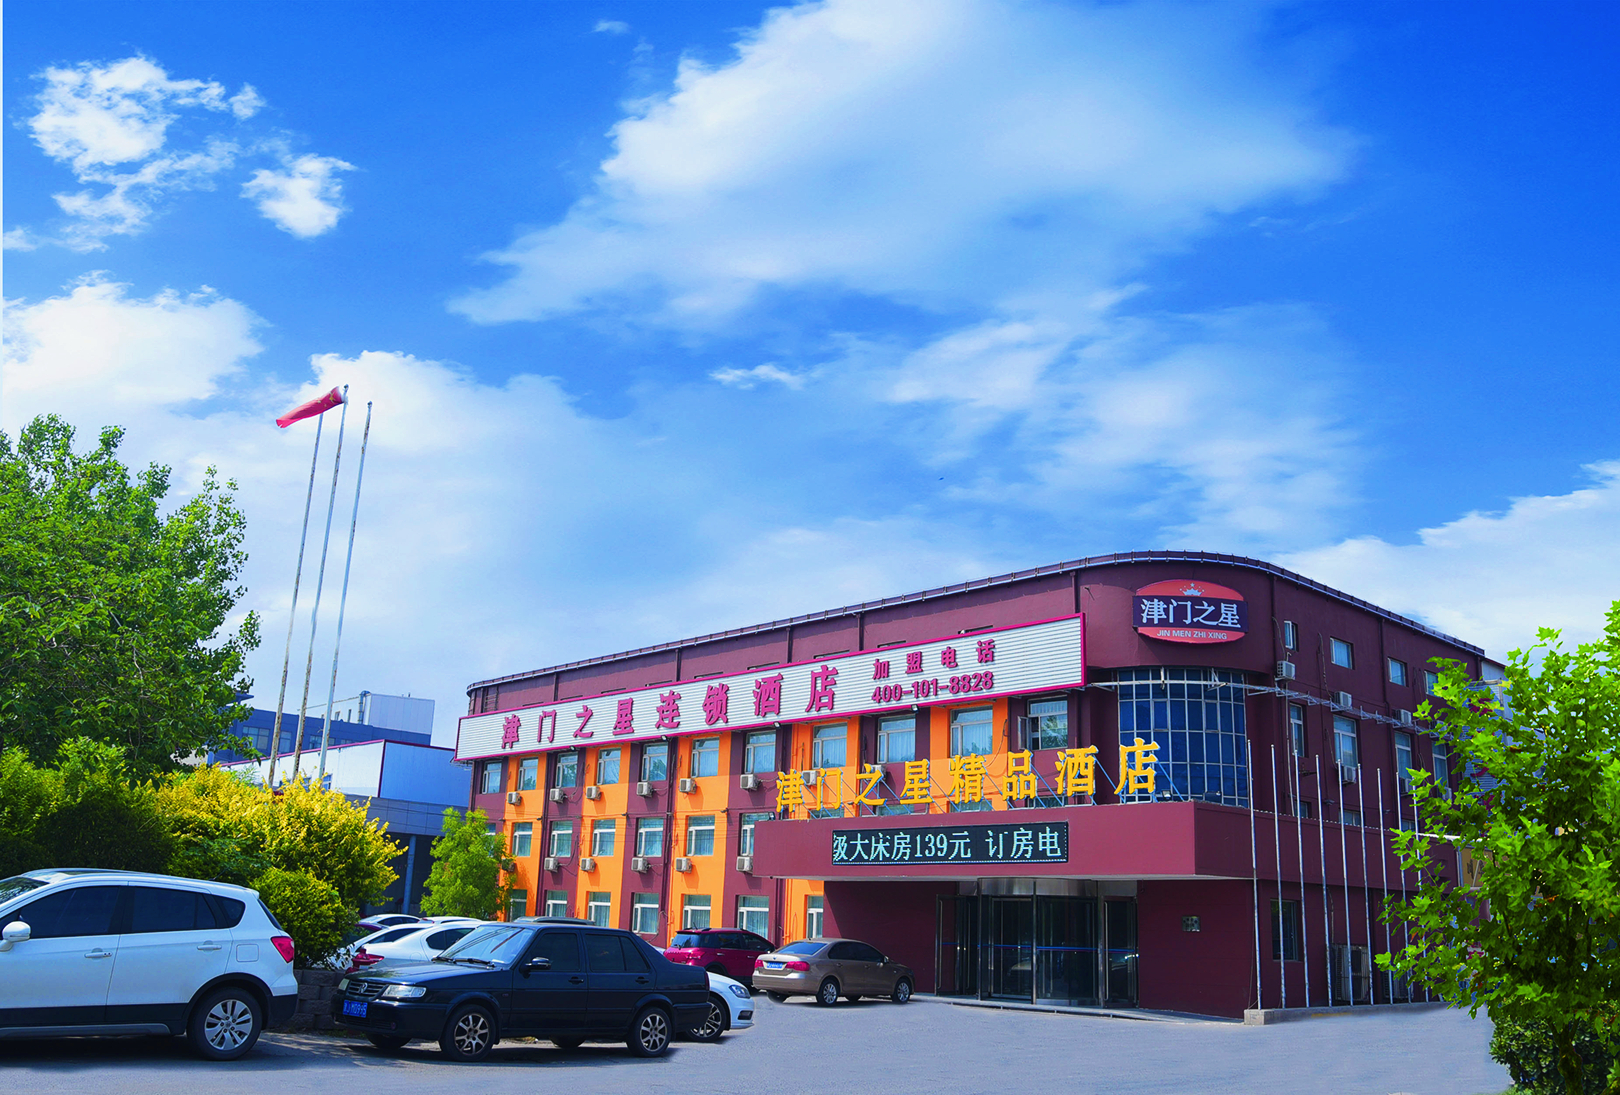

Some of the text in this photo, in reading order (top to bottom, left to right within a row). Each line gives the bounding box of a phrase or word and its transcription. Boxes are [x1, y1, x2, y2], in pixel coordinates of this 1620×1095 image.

[1140, 598, 1241, 628] 津门之星
[872, 639, 996, 681] 加盟电话
[871, 670, 995, 704] 400-101-8828
[501, 664, 839, 750] 津门之星连锁酒店
[775, 737, 1161, 813] 津门之星精品酒店
[985, 826, 1062, 859] 订房电
